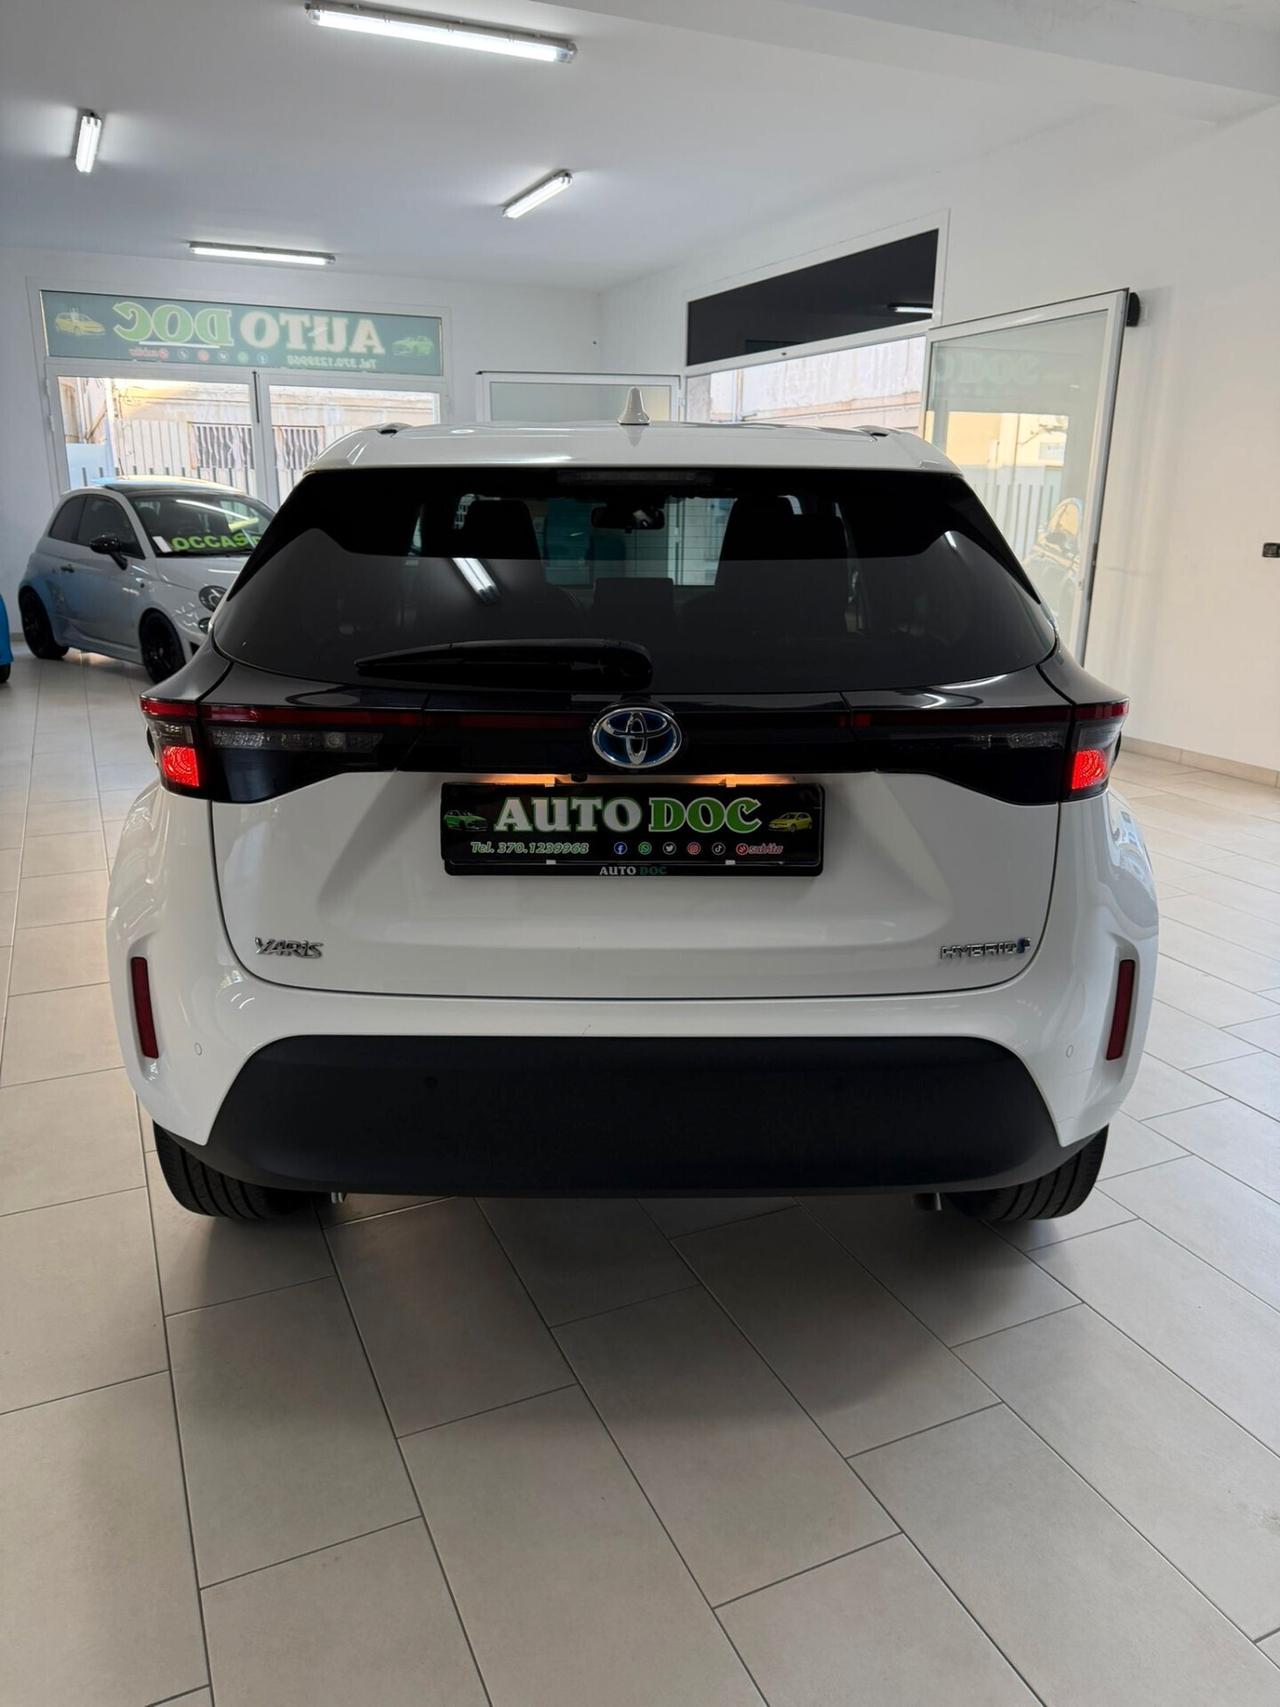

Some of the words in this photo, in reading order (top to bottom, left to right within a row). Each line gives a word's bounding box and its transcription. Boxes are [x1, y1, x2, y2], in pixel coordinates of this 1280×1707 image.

[493, 796, 643, 833] AUTO
[648, 796, 762, 834] DOC
[470, 841, 495, 854] Tel.
[497, 842, 590, 855] 370.1239968
[599, 866, 637, 876] AUTO
[639, 866, 668, 876] DOC
[254, 936, 324, 959] YARIS
[940, 941, 1018, 959] HYBRID
